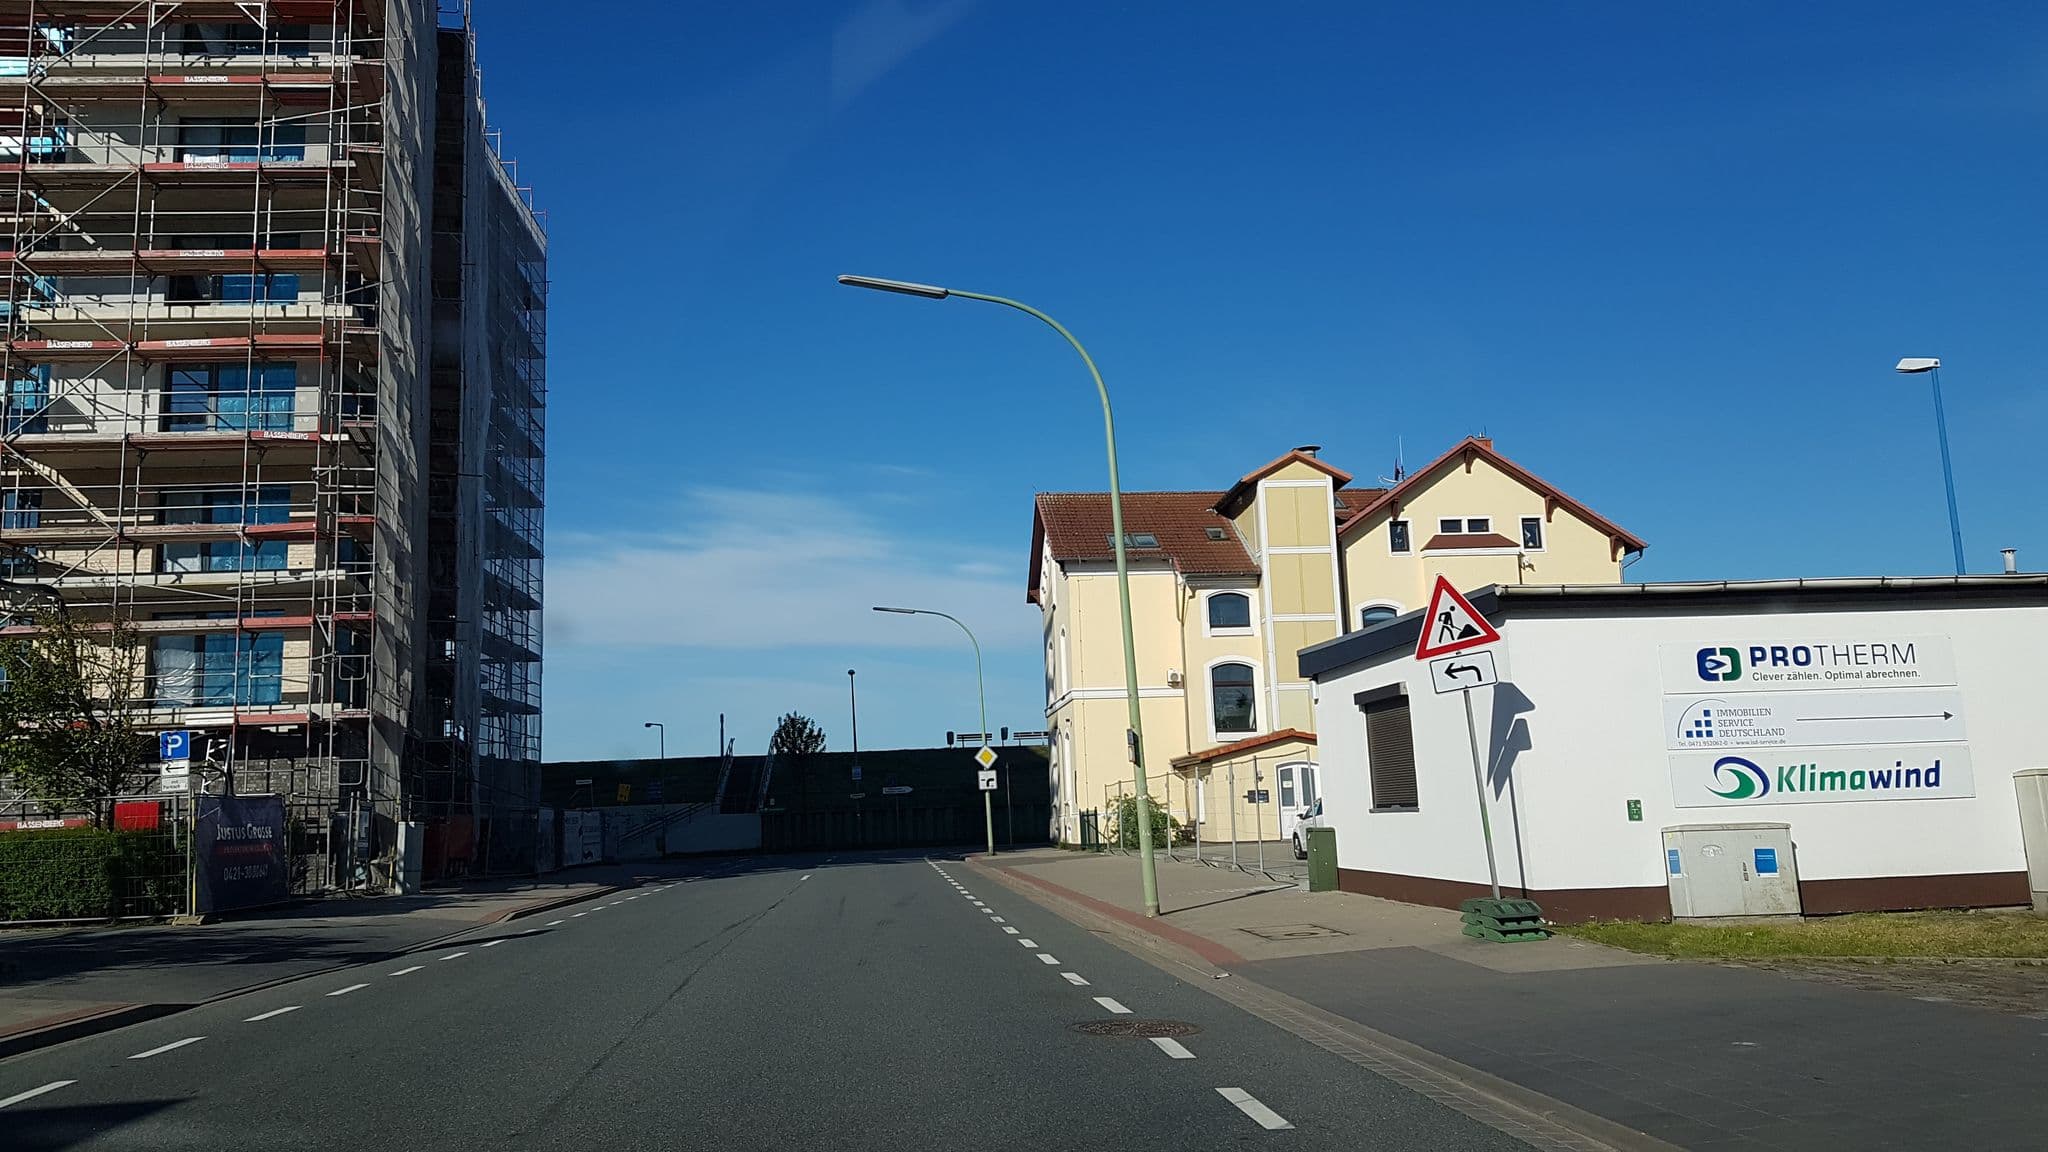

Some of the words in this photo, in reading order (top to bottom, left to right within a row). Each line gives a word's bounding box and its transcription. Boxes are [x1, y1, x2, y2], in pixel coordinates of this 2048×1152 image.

[1749, 643, 1916, 667] PROTHERM
[1752, 671, 1784, 681] Clever
[1787, 671, 1822, 681] zählen.
[1824, 670, 1863, 681] Optimal
[1866, 669, 1921, 679] abrechnen.
[1716, 708, 1772, 717] IMMOBILIEN
[1718, 718, 1754, 727] SERVICE
[1719, 727, 1785, 738] DEUTSCHLAND
[1777, 759, 1941, 793] Klimawind
